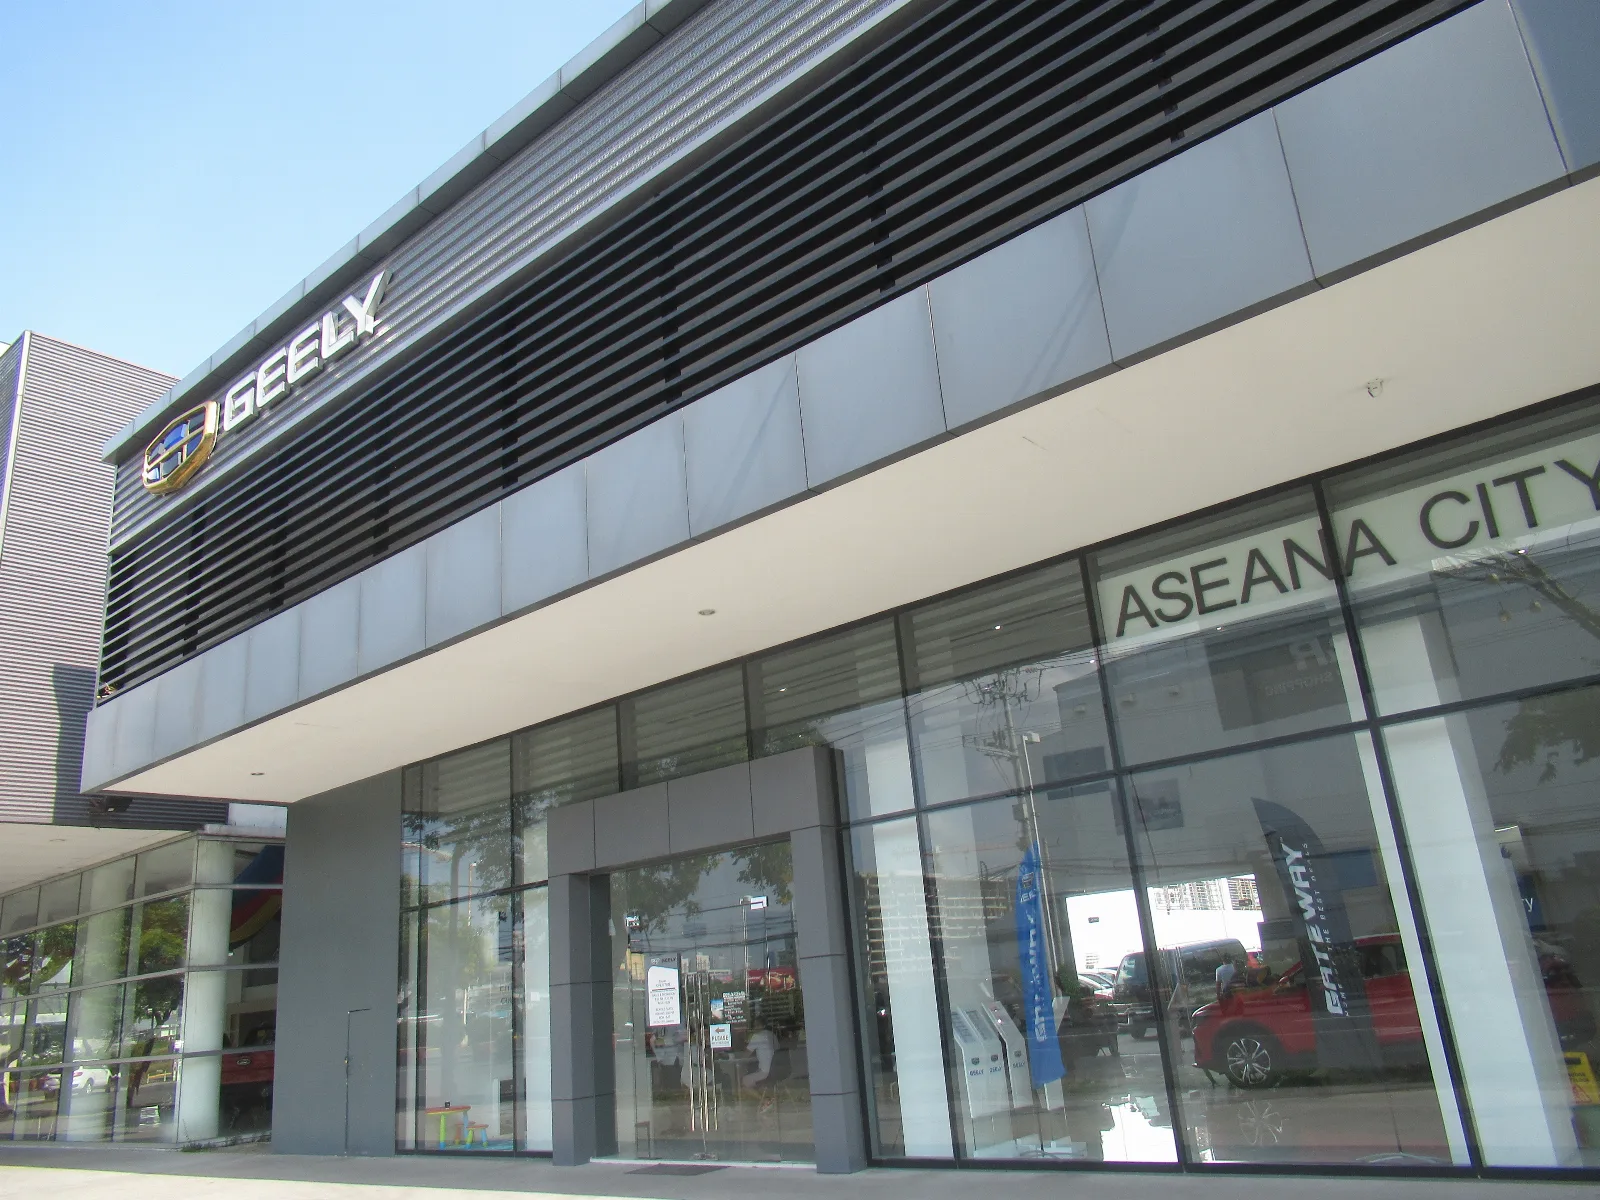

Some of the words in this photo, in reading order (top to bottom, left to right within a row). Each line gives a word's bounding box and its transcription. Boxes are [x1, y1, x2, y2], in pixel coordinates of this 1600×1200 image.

[222, 269, 393, 432] GEELY
[1115, 518, 1398, 637] ASEANA
[1418, 457, 1600, 550] CITY
[1280, 842, 1344, 1015] GATEWAY
[1313, 889, 1327, 920] BEST
